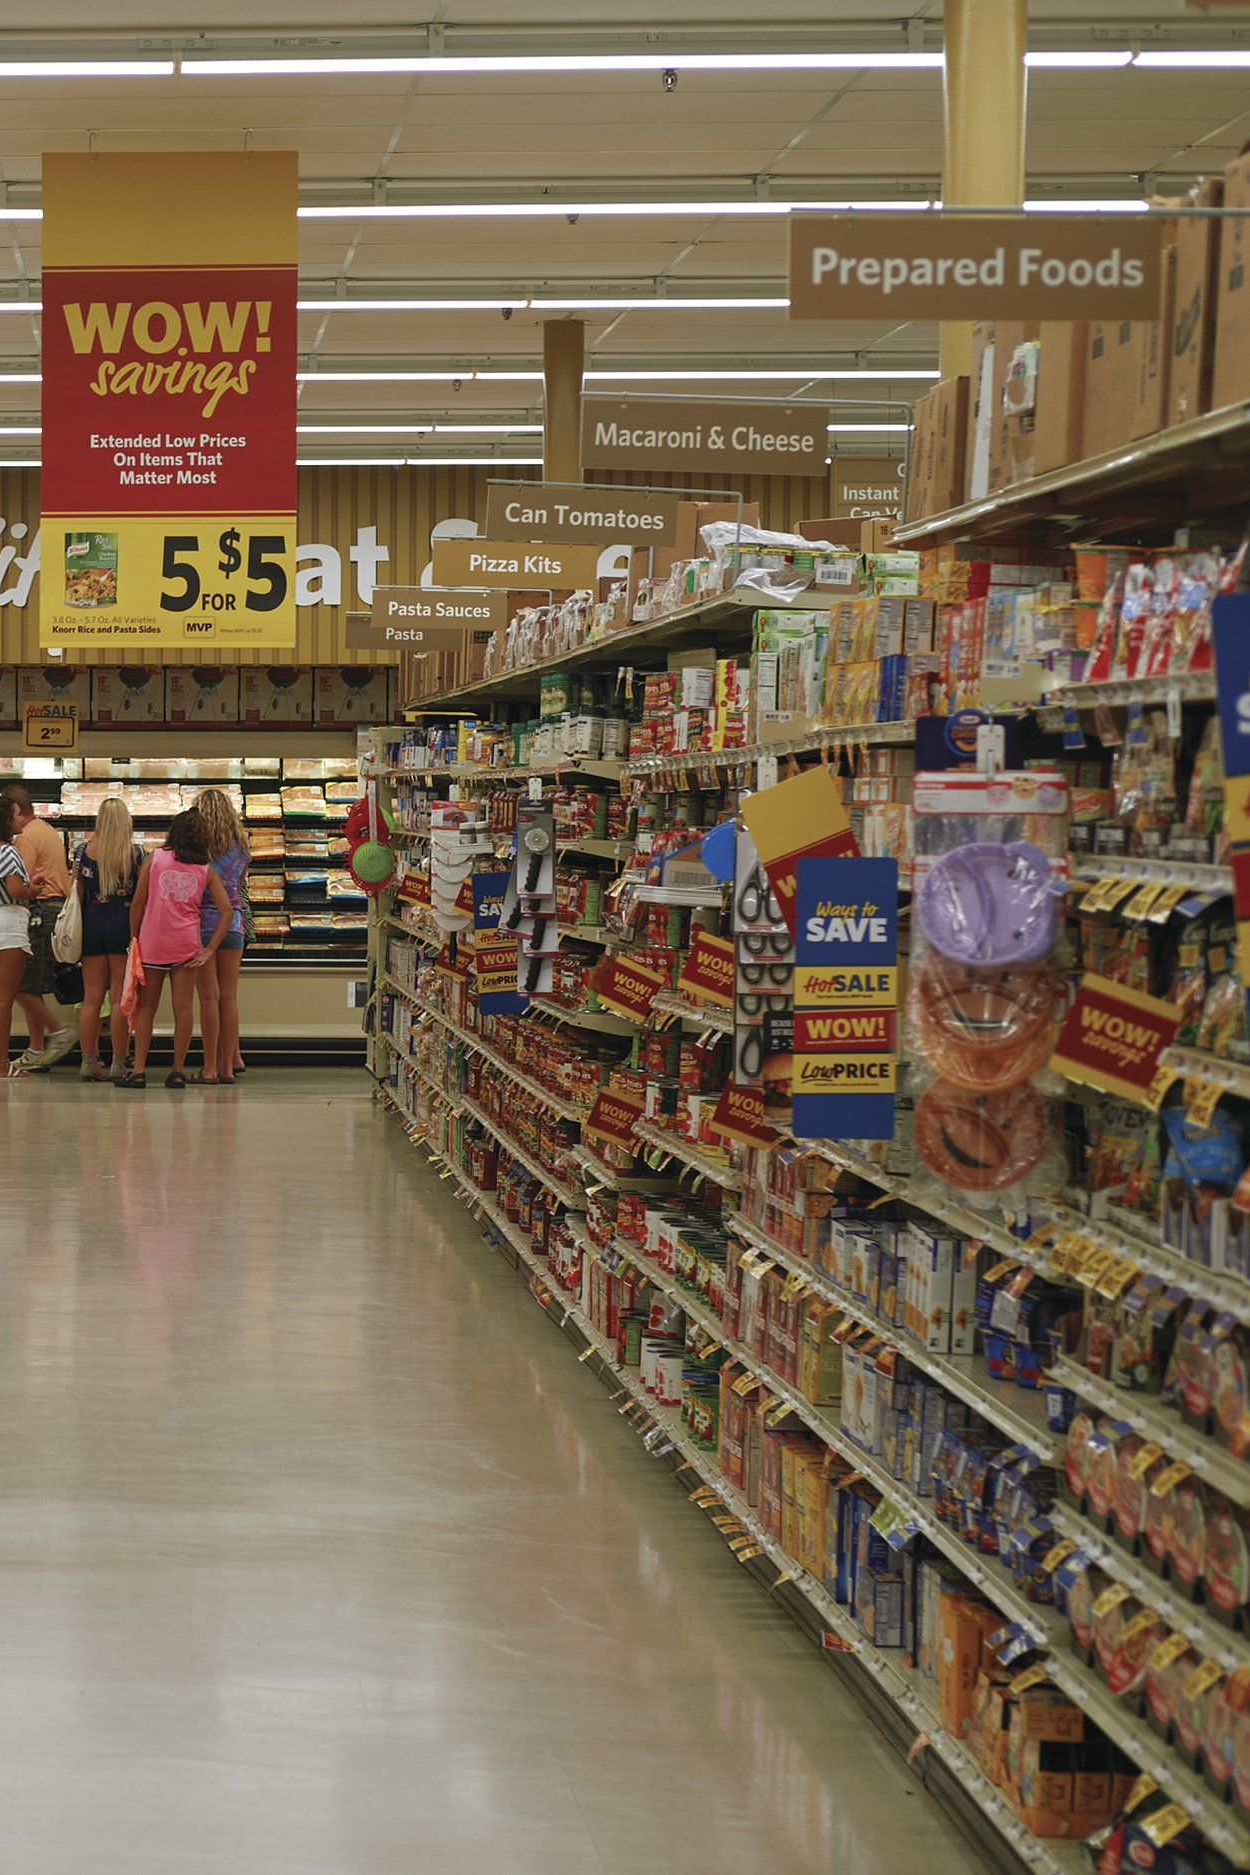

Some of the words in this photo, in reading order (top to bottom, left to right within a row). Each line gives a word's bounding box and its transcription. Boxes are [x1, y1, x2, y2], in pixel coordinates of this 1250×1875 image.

[811, 247, 1005, 294] Prepared
[1018, 248, 1144, 287] Foods
[63, 301, 272, 354] WOW!
[90, 354, 257, 418] savings
[90, 434, 161, 448] Extended
[165, 434, 196, 448] Low
[200, 434, 246, 447] Prices
[595, 422, 701, 450] Macaroni
[707, 427, 725, 450] &
[732, 427, 815, 453] Cheese
[113, 453, 136, 467] On
[140, 453, 183, 466] Items
[187, 452, 223, 466] That
[119, 471, 173, 485] Matter
[176, 471, 216, 484] Most
[843, 486, 899, 500] Instant
[504, 502, 547, 525] Can
[554, 505, 664, 531] Tomatoes
[160, 536, 200, 612] 5
[202, 594, 236, 611] FOR
[469, 554, 518, 573] Pizza
[524, 555, 562, 574] Kits
[112, 616, 123, 624] All
[124, 615, 157, 624] Varieties
[388, 602, 432, 617] Pasta
[435, 602, 490, 618] Sauces
[52, 625, 76, 634] Knorr
[78, 625, 96, 634] Rice
[97, 625, 112, 634] and
[114, 625, 137, 634] Pasta
[138, 625, 161, 634] Sides
[186, 623, 212, 632] MVP
[385, 628, 424, 642] Pasta
[815, 901, 858, 926] Ways
[862, 901, 879, 917] to
[806, 917, 888, 943] SAVE
[483, 952, 518, 966] WOW
[614, 972, 652, 998] WOW!
[614, 984, 645, 1004] savings
[806, 1017, 886, 1041] WOW!
[1081, 1005, 1161, 1052] WOW!
[1082, 1032, 1147, 1068] savings
[600, 1102, 634, 1122] WOW!
